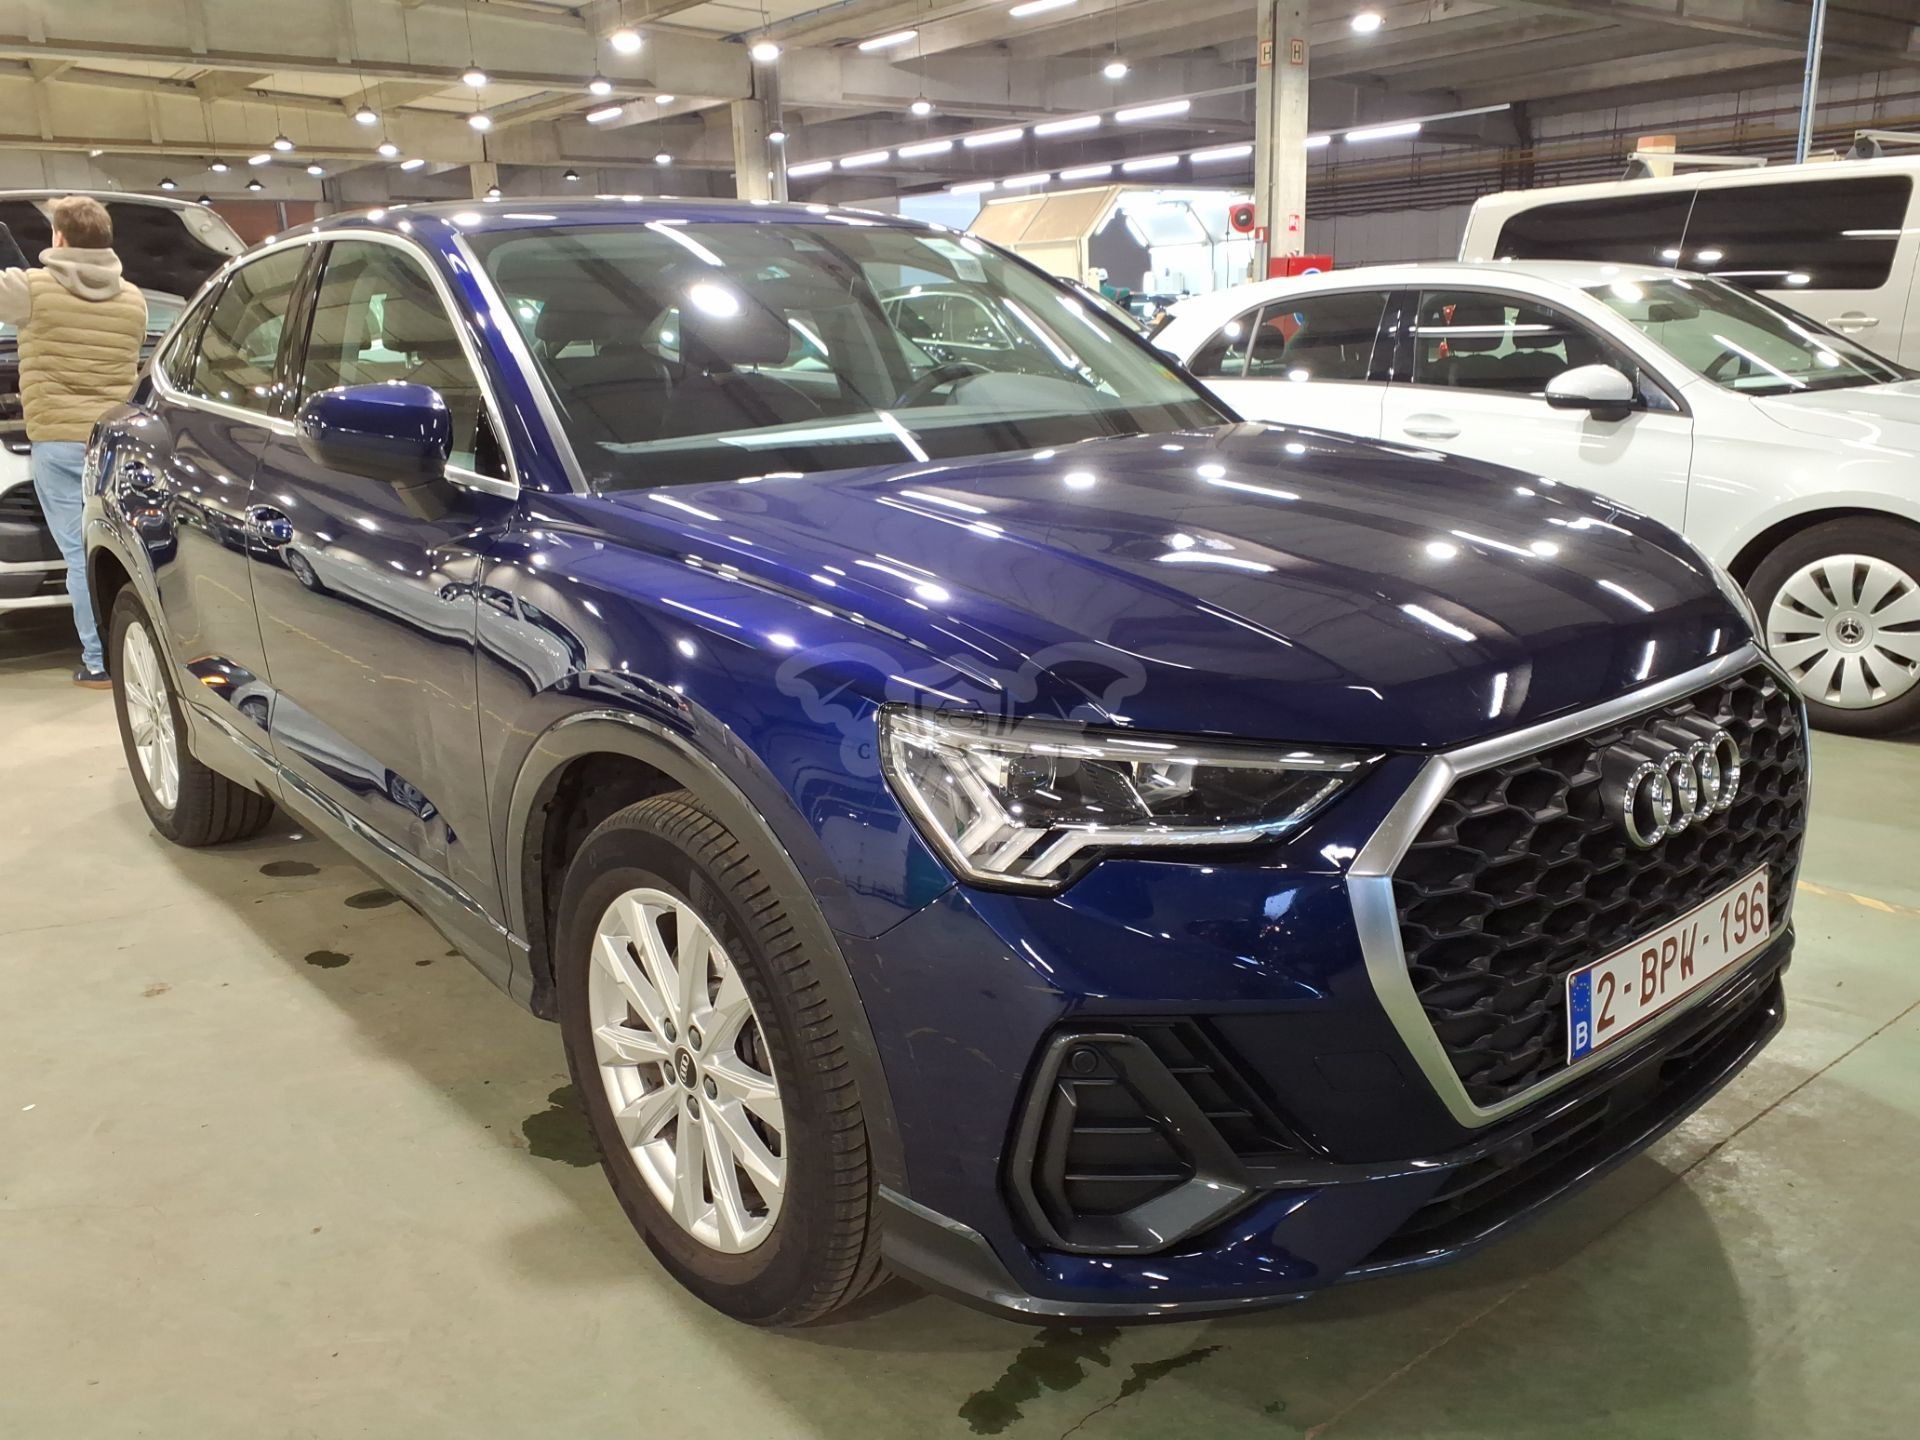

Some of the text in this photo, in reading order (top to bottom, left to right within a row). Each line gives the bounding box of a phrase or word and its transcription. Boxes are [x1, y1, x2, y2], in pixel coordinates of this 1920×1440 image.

[1263, 45, 1272, 61] H
[1293, 43, 1301, 60] H
[1597, 881, 1765, 1033] 2-BPW-196
[1576, 1021, 1588, 1050] B
